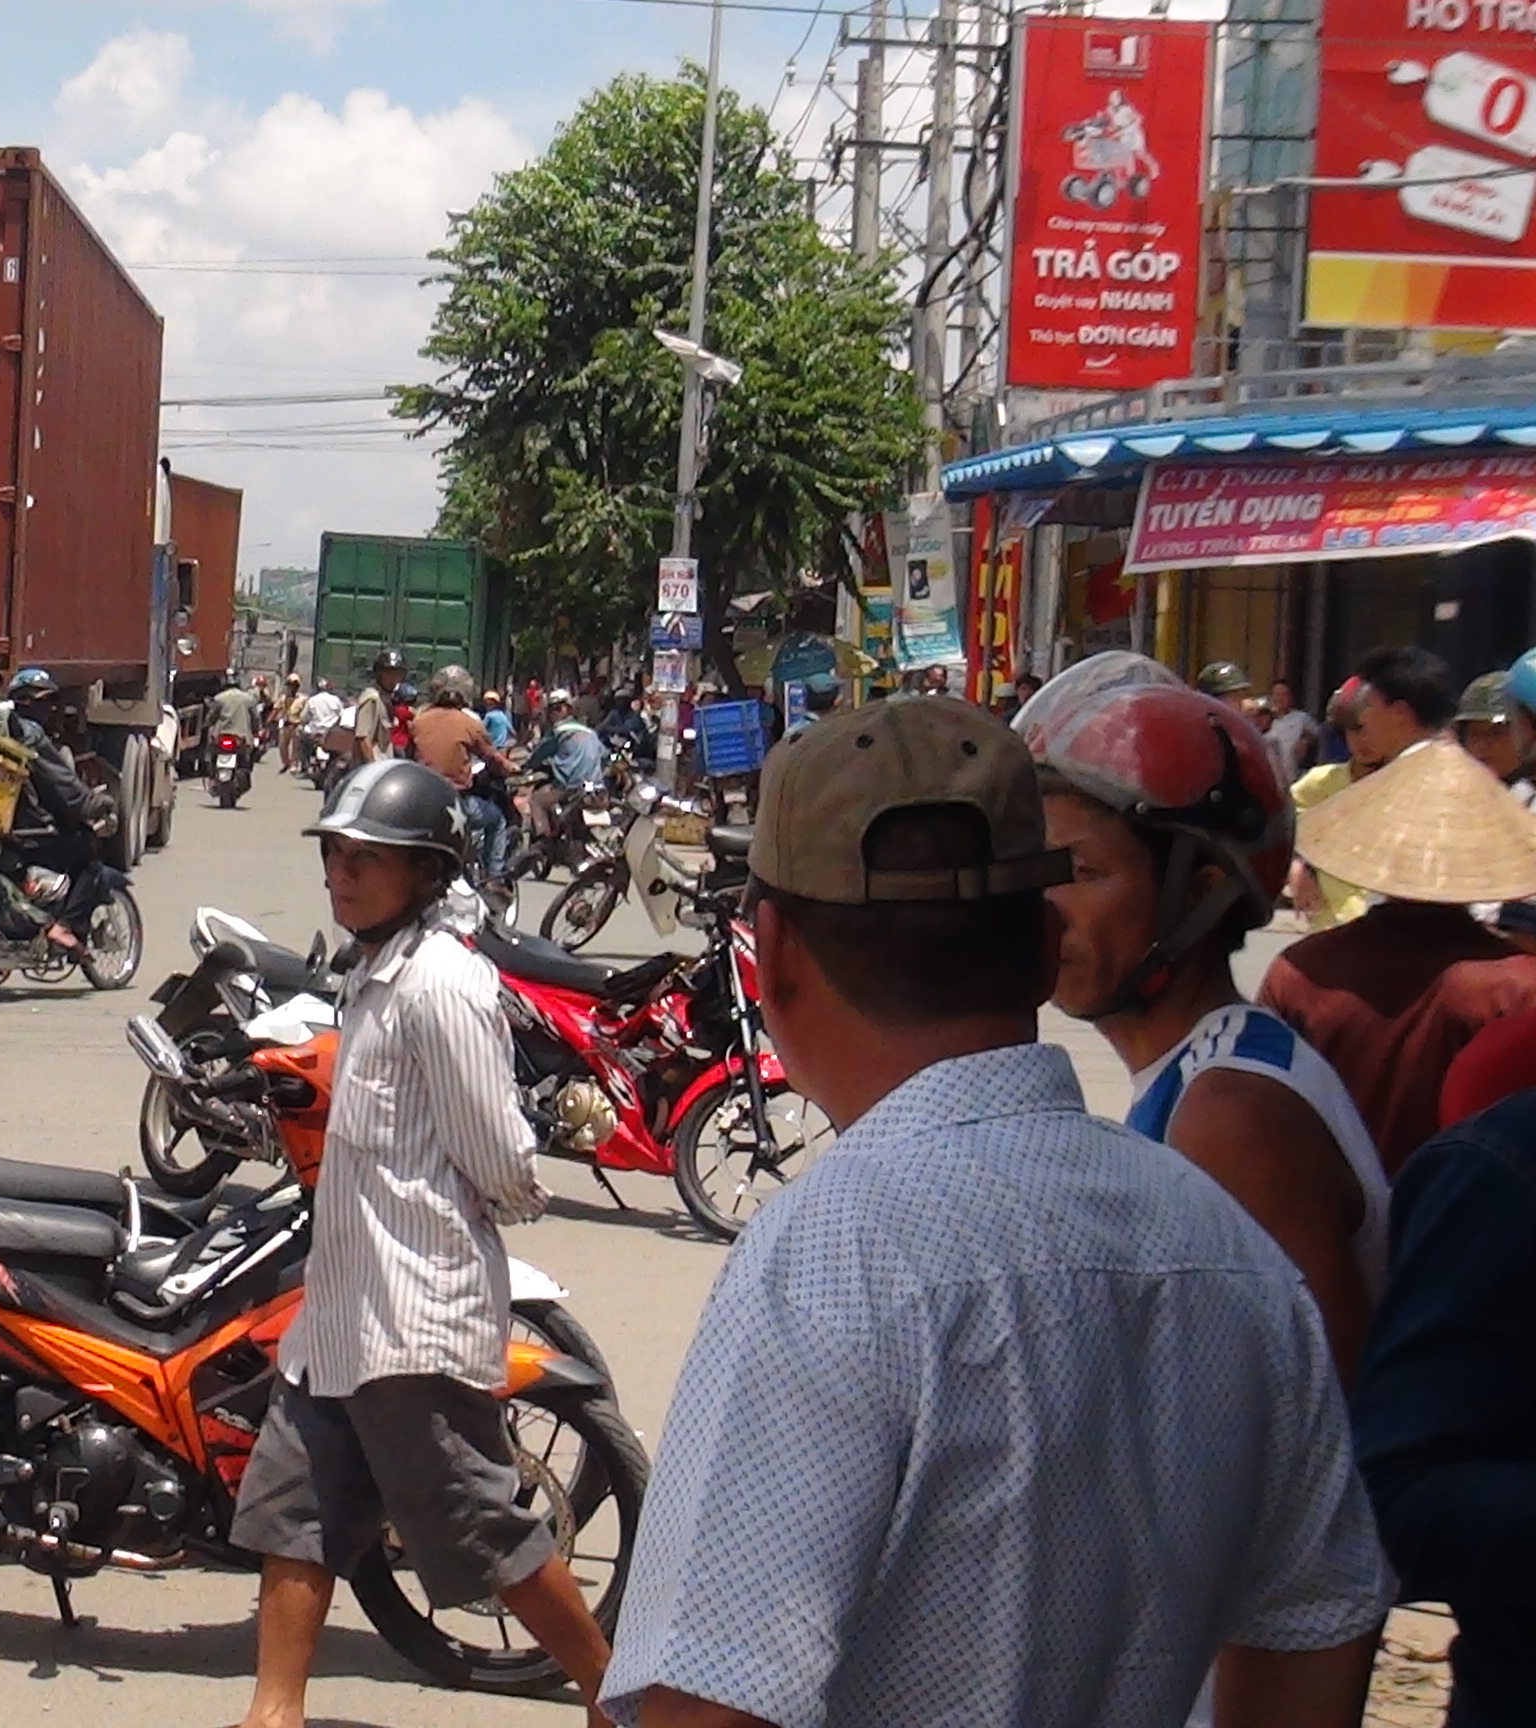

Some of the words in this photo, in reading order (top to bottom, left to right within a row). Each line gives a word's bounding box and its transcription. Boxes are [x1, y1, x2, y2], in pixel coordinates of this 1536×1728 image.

[5, 258, 18, 282] 6
[1106, 242, 1180, 281] GÓP
[1100, 290, 1174, 311] NHANH
[1239, 493, 1324, 531] DỤNG
